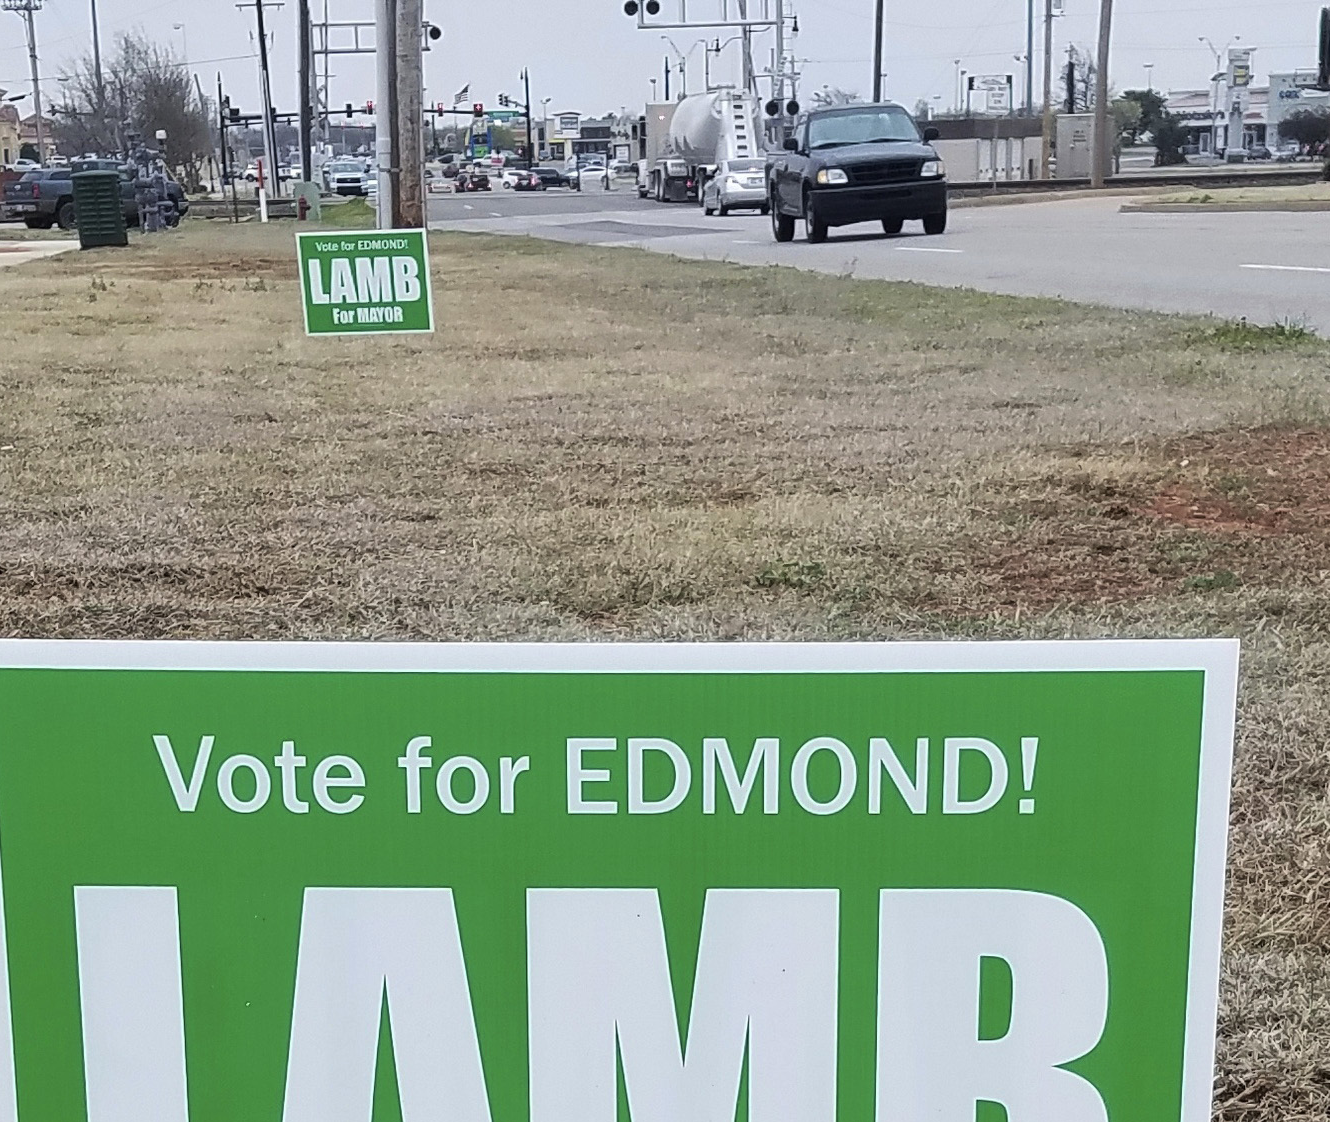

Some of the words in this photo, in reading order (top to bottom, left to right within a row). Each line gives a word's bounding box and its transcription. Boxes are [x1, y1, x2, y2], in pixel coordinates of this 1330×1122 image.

[315, 241, 338, 252] Vote
[341, 241, 355, 251] for
[357, 239, 409, 250] EDMOND!
[308, 256, 421, 304] LAMB
[332, 308, 355, 324] For
[356, 306, 403, 323] MAYOR
[153, 736, 365, 813] Vote
[398, 736, 530, 814] for
[567, 737, 1039, 814] EDMOND!
